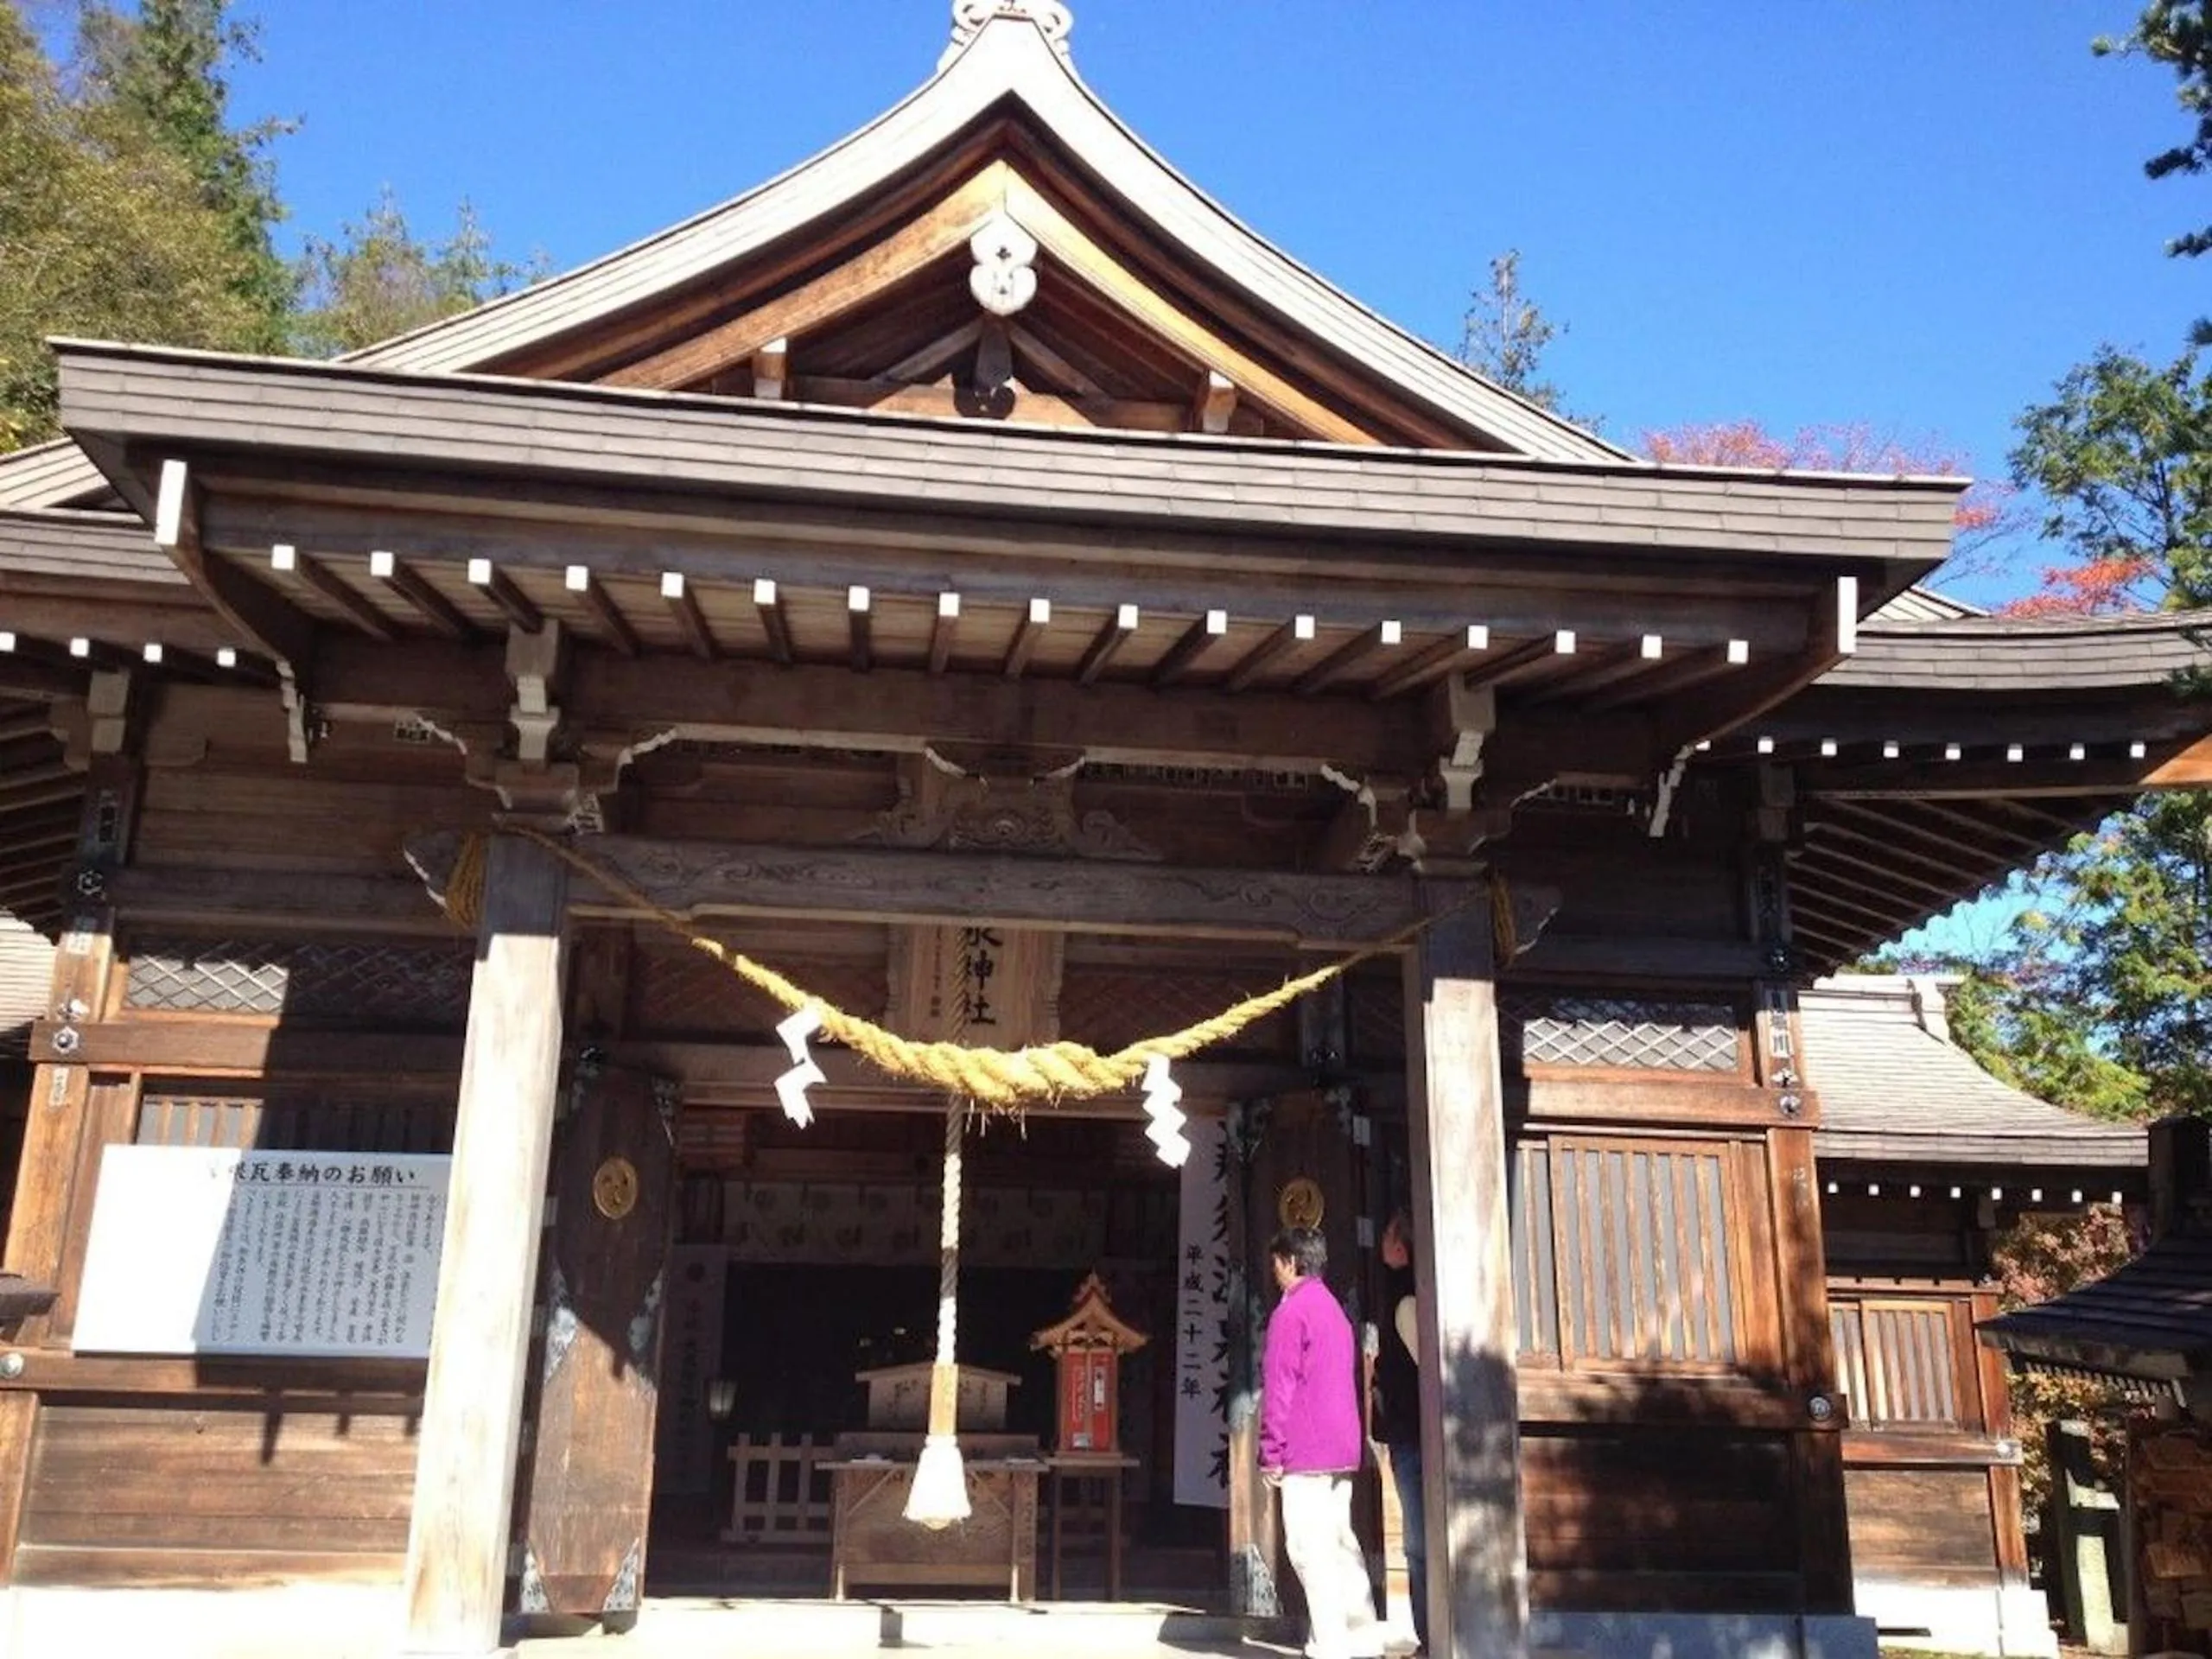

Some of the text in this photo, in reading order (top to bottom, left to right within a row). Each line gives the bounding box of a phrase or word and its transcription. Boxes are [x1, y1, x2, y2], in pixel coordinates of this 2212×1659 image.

[1180, 1243, 1204, 1400] 平成二十二年
